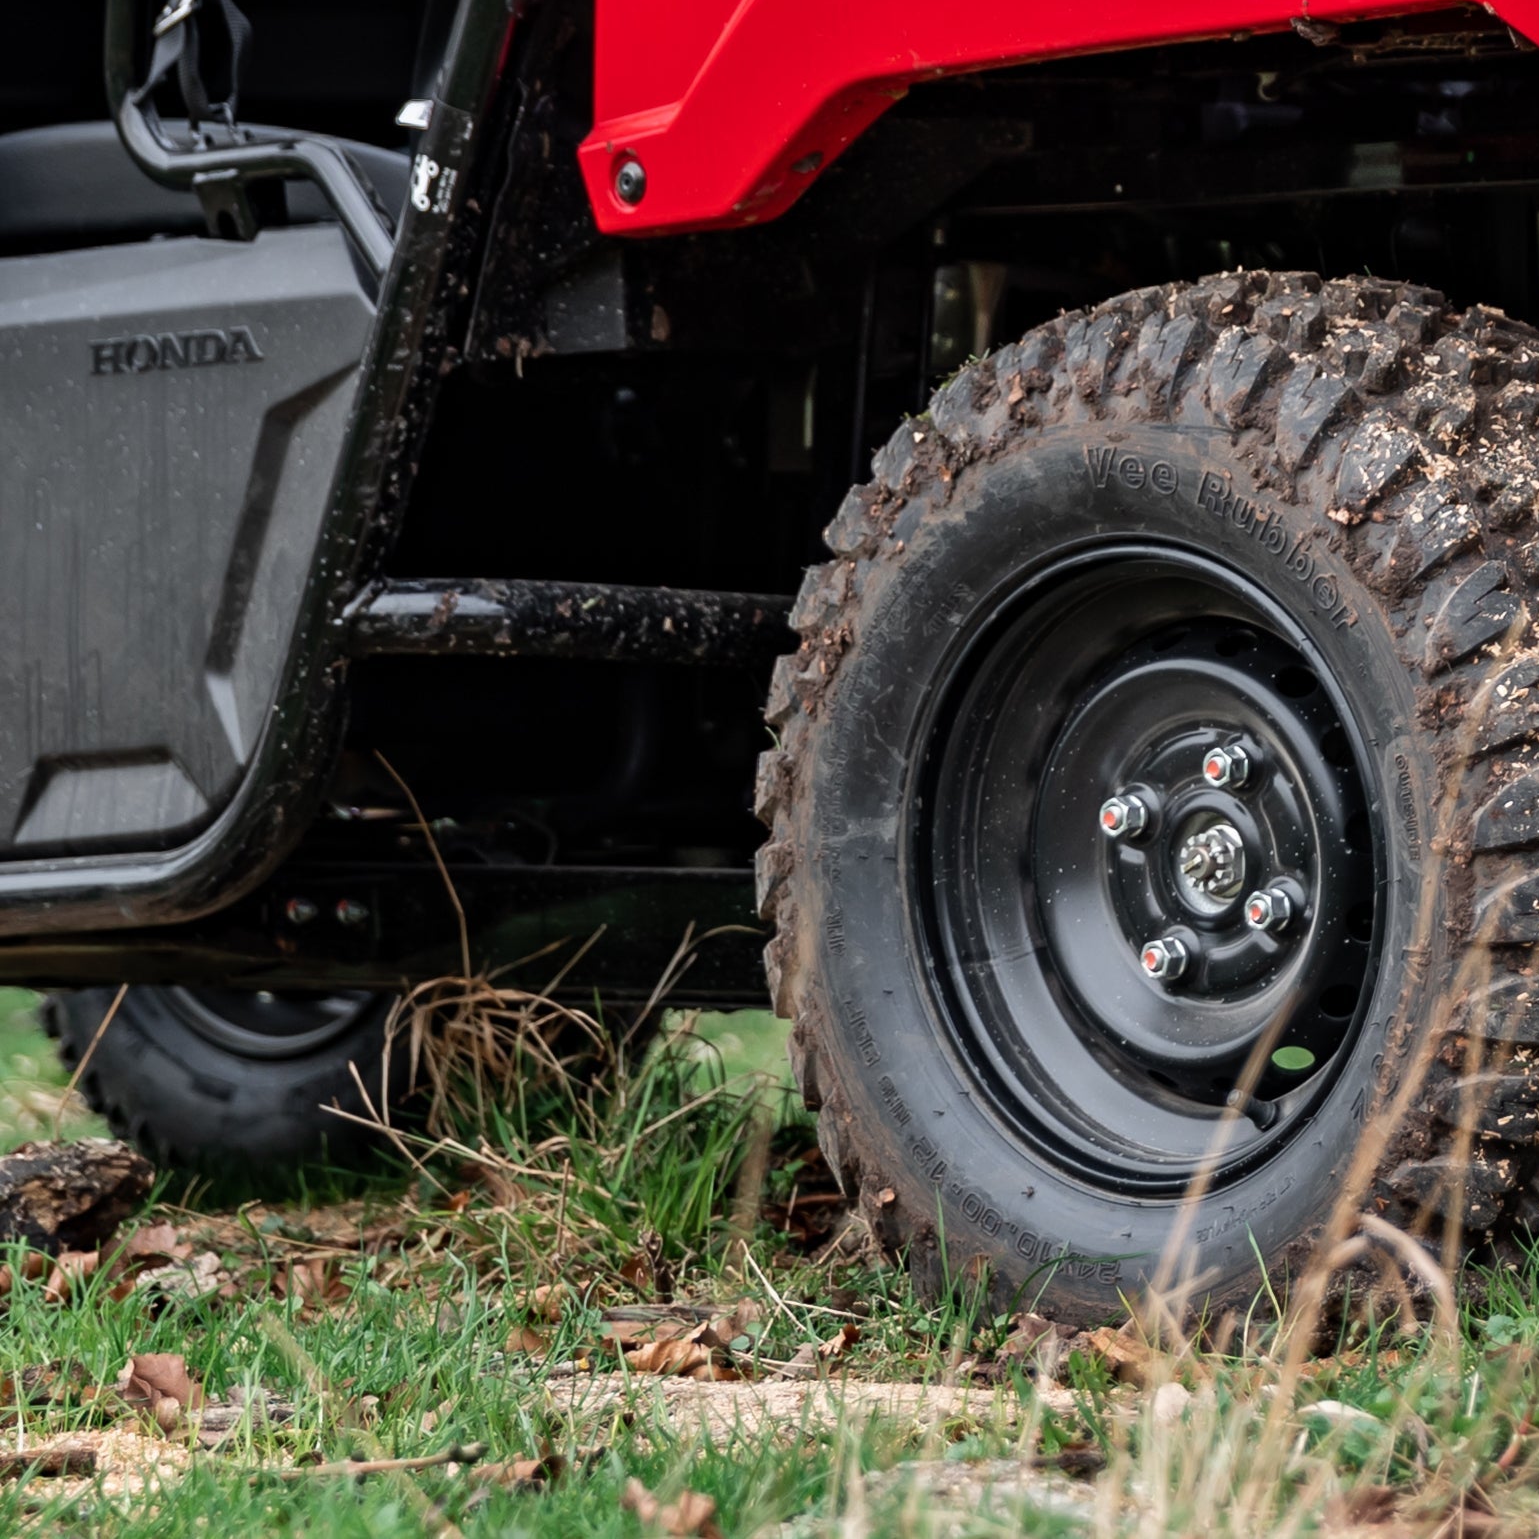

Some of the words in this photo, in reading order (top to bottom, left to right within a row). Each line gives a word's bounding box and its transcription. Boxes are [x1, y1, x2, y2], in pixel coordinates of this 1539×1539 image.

[88, 324, 264, 375] HONDA
[1083, 443, 1178, 495] Vee
[1196, 468, 1359, 629] Rubber
